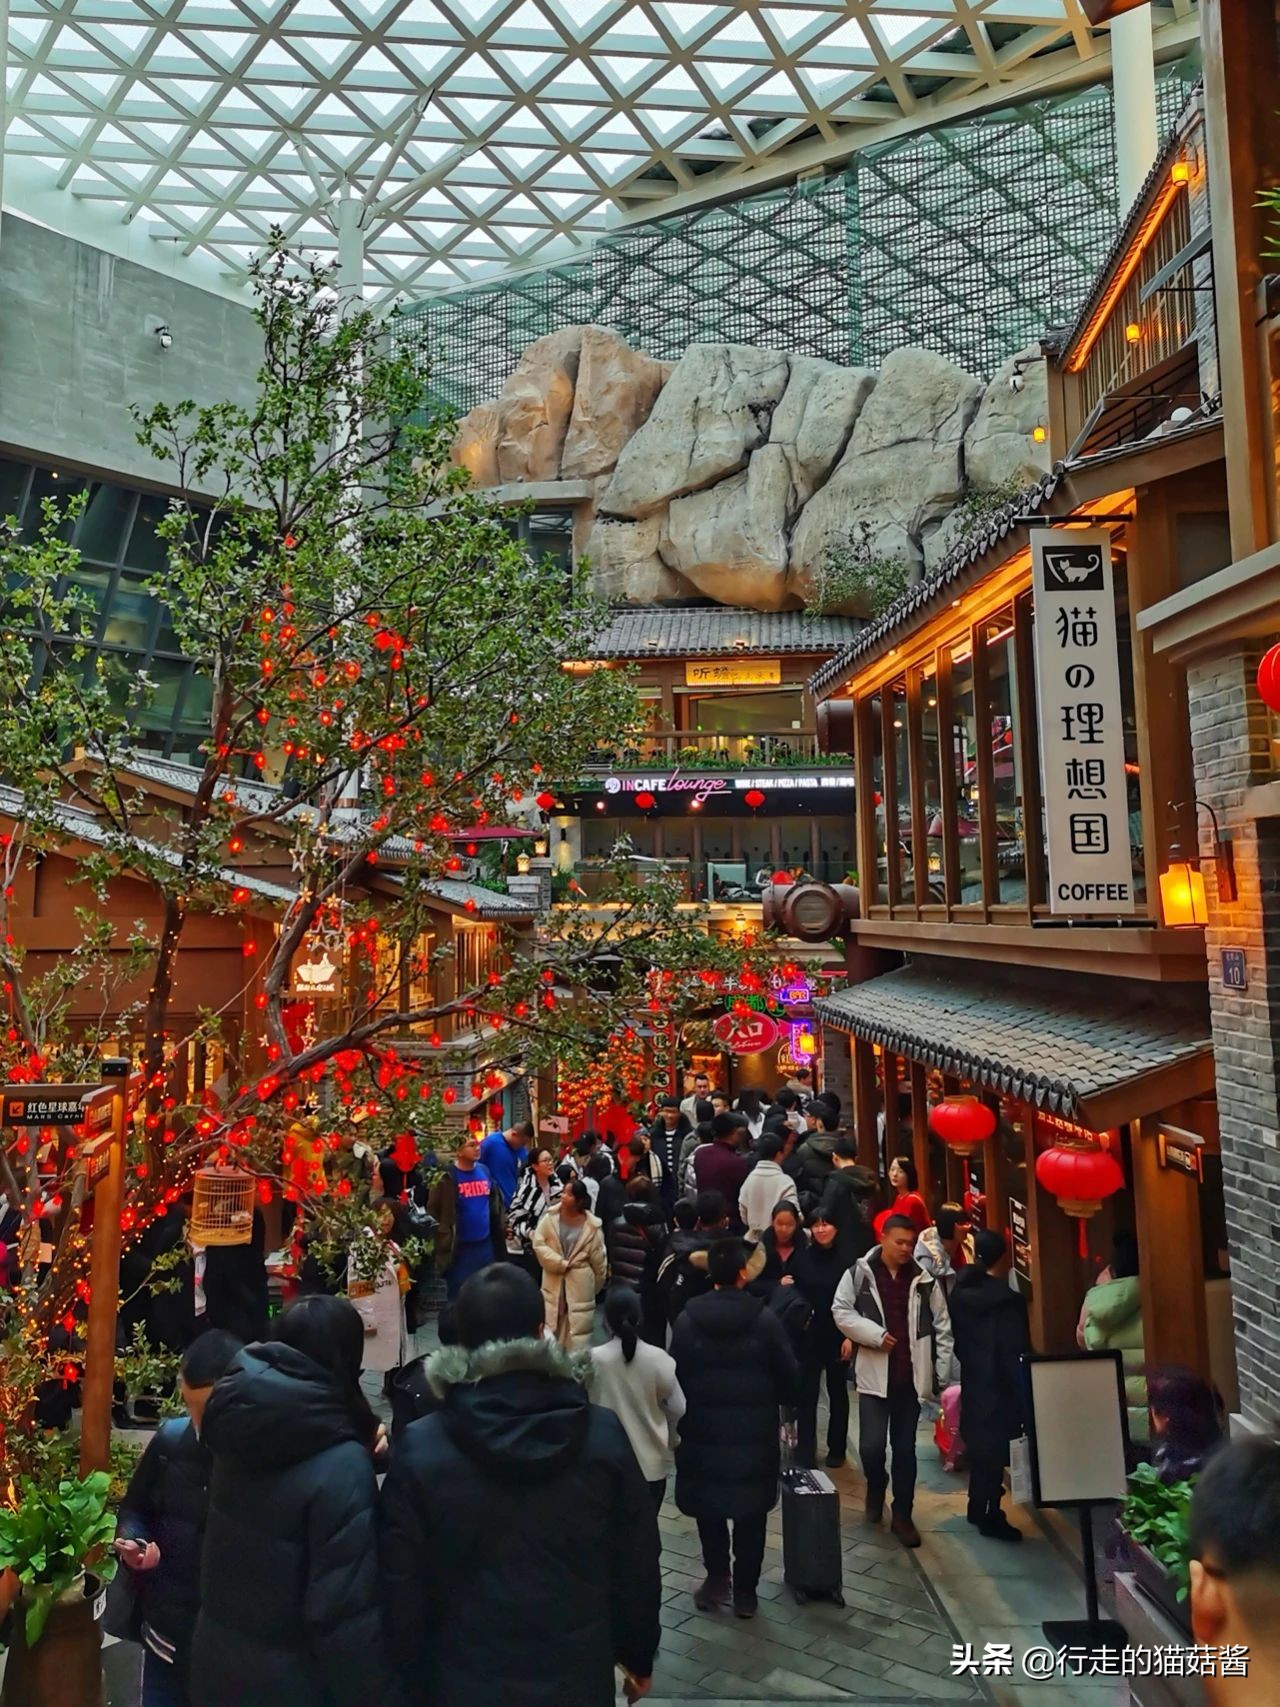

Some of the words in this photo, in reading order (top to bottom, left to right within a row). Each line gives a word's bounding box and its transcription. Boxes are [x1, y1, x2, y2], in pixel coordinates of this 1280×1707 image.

[1056, 607, 1109, 854] 猫の理想国
[667, 766, 732, 801] lounge
[1058, 883, 1129, 901] COFFEE
[1229, 967, 1240, 984] 10
[458, 1181, 490, 1197] PRIDE
